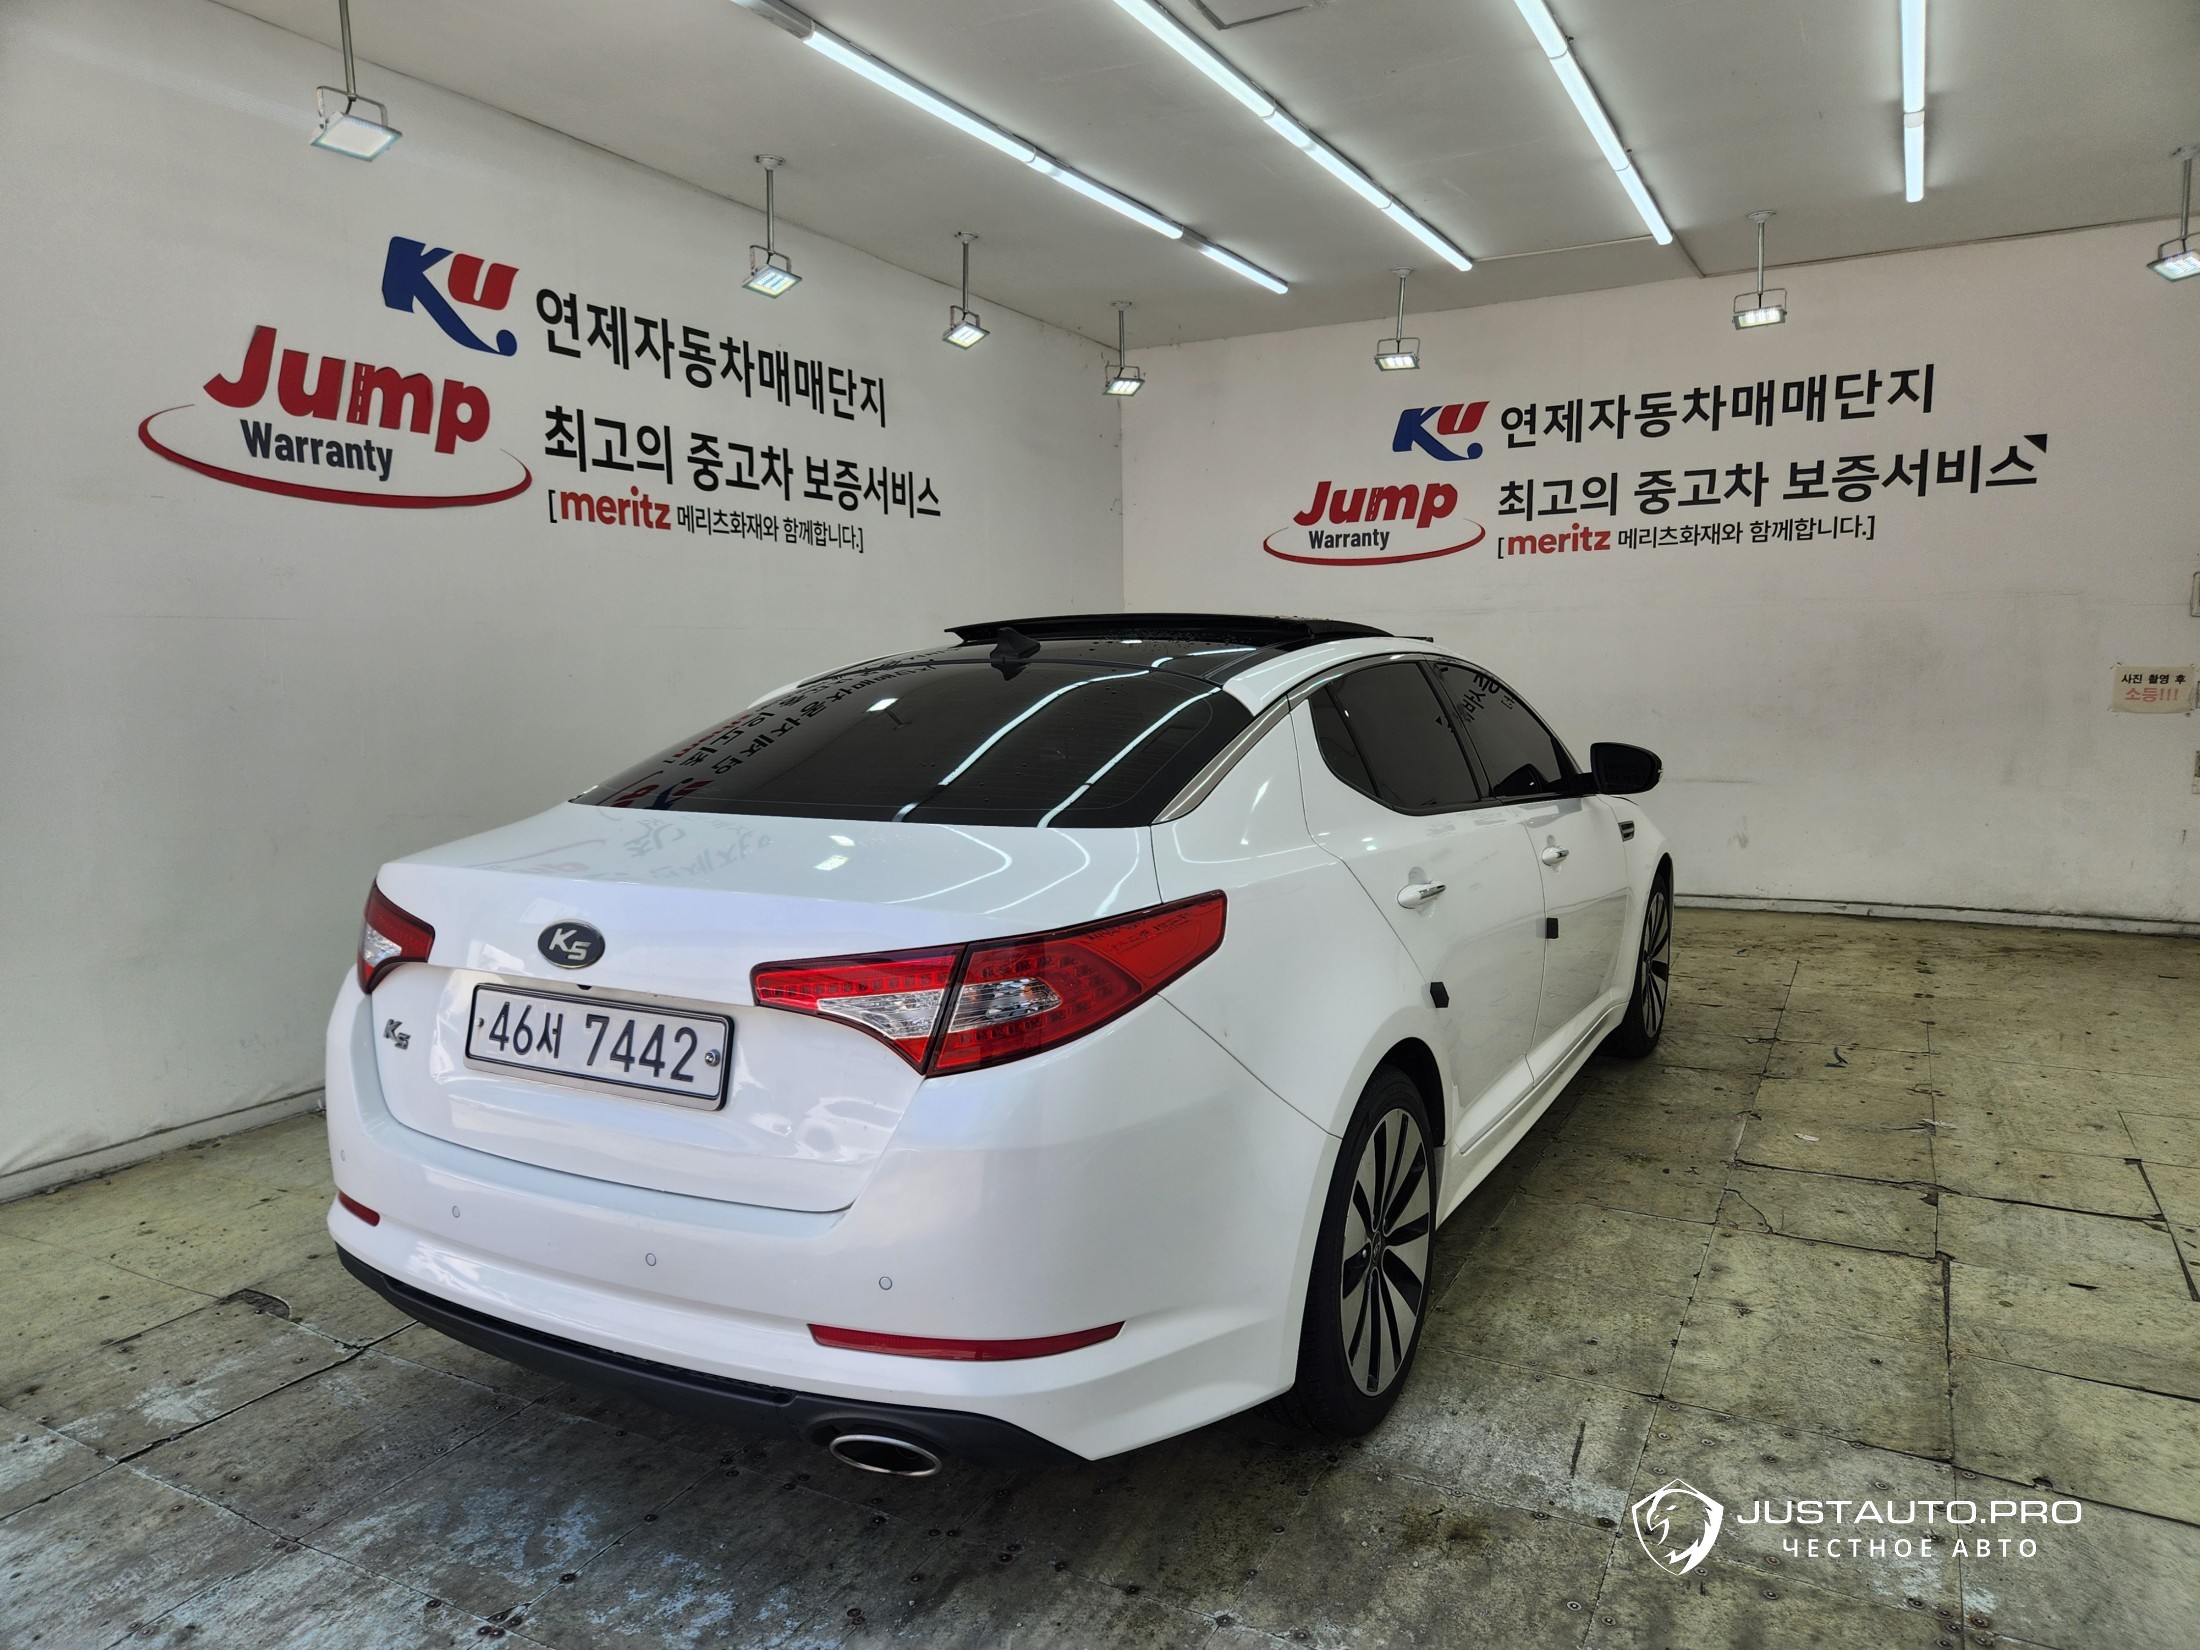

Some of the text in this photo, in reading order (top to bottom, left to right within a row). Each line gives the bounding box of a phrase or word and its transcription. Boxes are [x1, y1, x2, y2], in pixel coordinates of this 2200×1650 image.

[203, 324, 491, 455] Jump
[536, 288, 887, 428] 연제자동차매매단지
[1500, 363, 1936, 449] 연제자동차매매단지
[239, 418, 393, 482] Warranty
[545, 405, 942, 519] 최고의 중고차 보증서비스
[1293, 480, 1458, 529] Jump
[1497, 443, 2038, 522] 최고의 중고차 보증서비스
[677, 504, 779, 543] 메리츠화재와
[1309, 528, 1390, 551] Warranty
[1617, 521, 1743, 550] 메리츠화재와
[2121, 673, 2143, 684] 사진
[2175, 674, 2186, 684] 후
[2125, 687, 2179, 702] 소등!!!
[488, 1001, 699, 1083] 46서 7442
